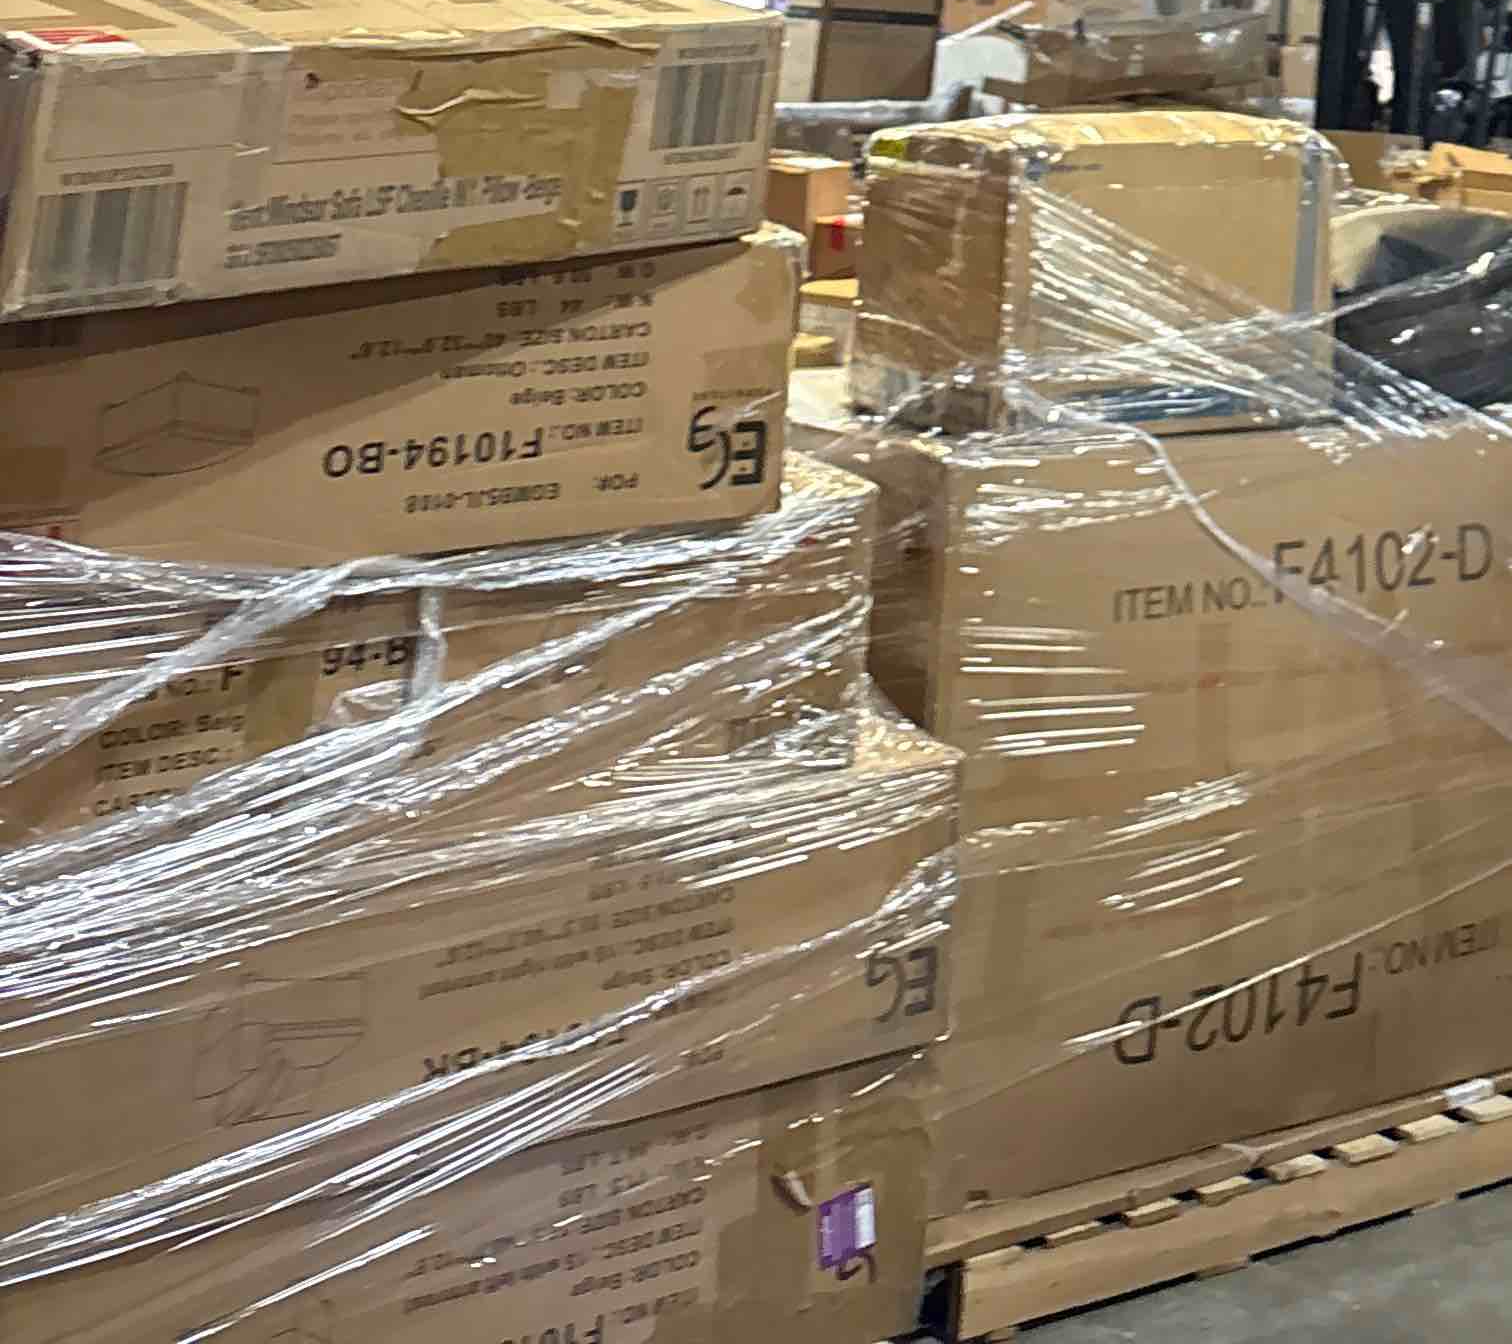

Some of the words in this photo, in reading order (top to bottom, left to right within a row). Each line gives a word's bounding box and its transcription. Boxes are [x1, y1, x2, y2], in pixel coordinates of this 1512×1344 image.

[322, 426, 545, 479] F10194-BO
[1112, 584, 1194, 623] ITEM
[1271, 523, 1494, 605] F4102-D
[1112, 949, 1363, 1065] F4102-D
